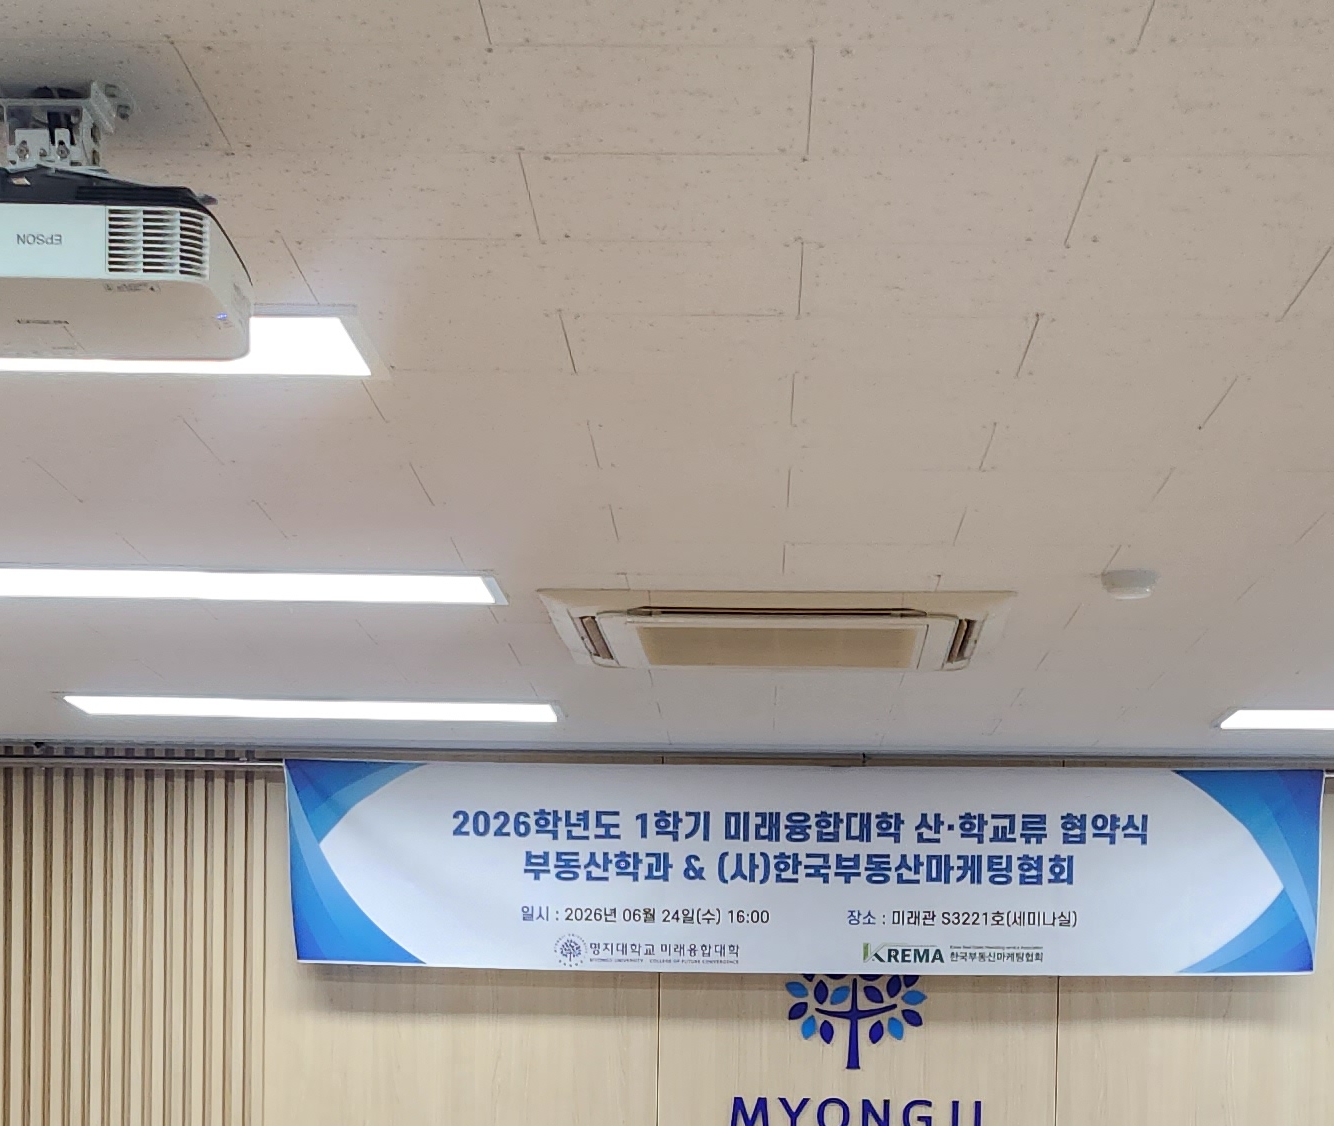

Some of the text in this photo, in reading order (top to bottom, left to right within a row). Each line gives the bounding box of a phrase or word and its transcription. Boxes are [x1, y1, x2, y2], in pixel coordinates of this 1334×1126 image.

[16, 233, 63, 246] EPSON
[452, 809, 1150, 847] 2026학년도 1학기 미래융합대학 산·학교류 협약식
[523, 850, 1075, 886] 부동산학과 & (사)한국부동산마케팅협회
[520, 905, 550, 923] 일시
[564, 906, 618, 924] 2026년
[622, 906, 656, 924] 06월
[661, 907, 722, 926] 24일(수)
[728, 909, 770, 925] 16:00
[846, 909, 877, 927] 장소
[891, 910, 937, 928] 미래관
[941, 909, 1078, 929] S3221호(세미나실)
[660, 943, 740, 958] 미래융합대학
[863, 942, 945, 964] KREMA
